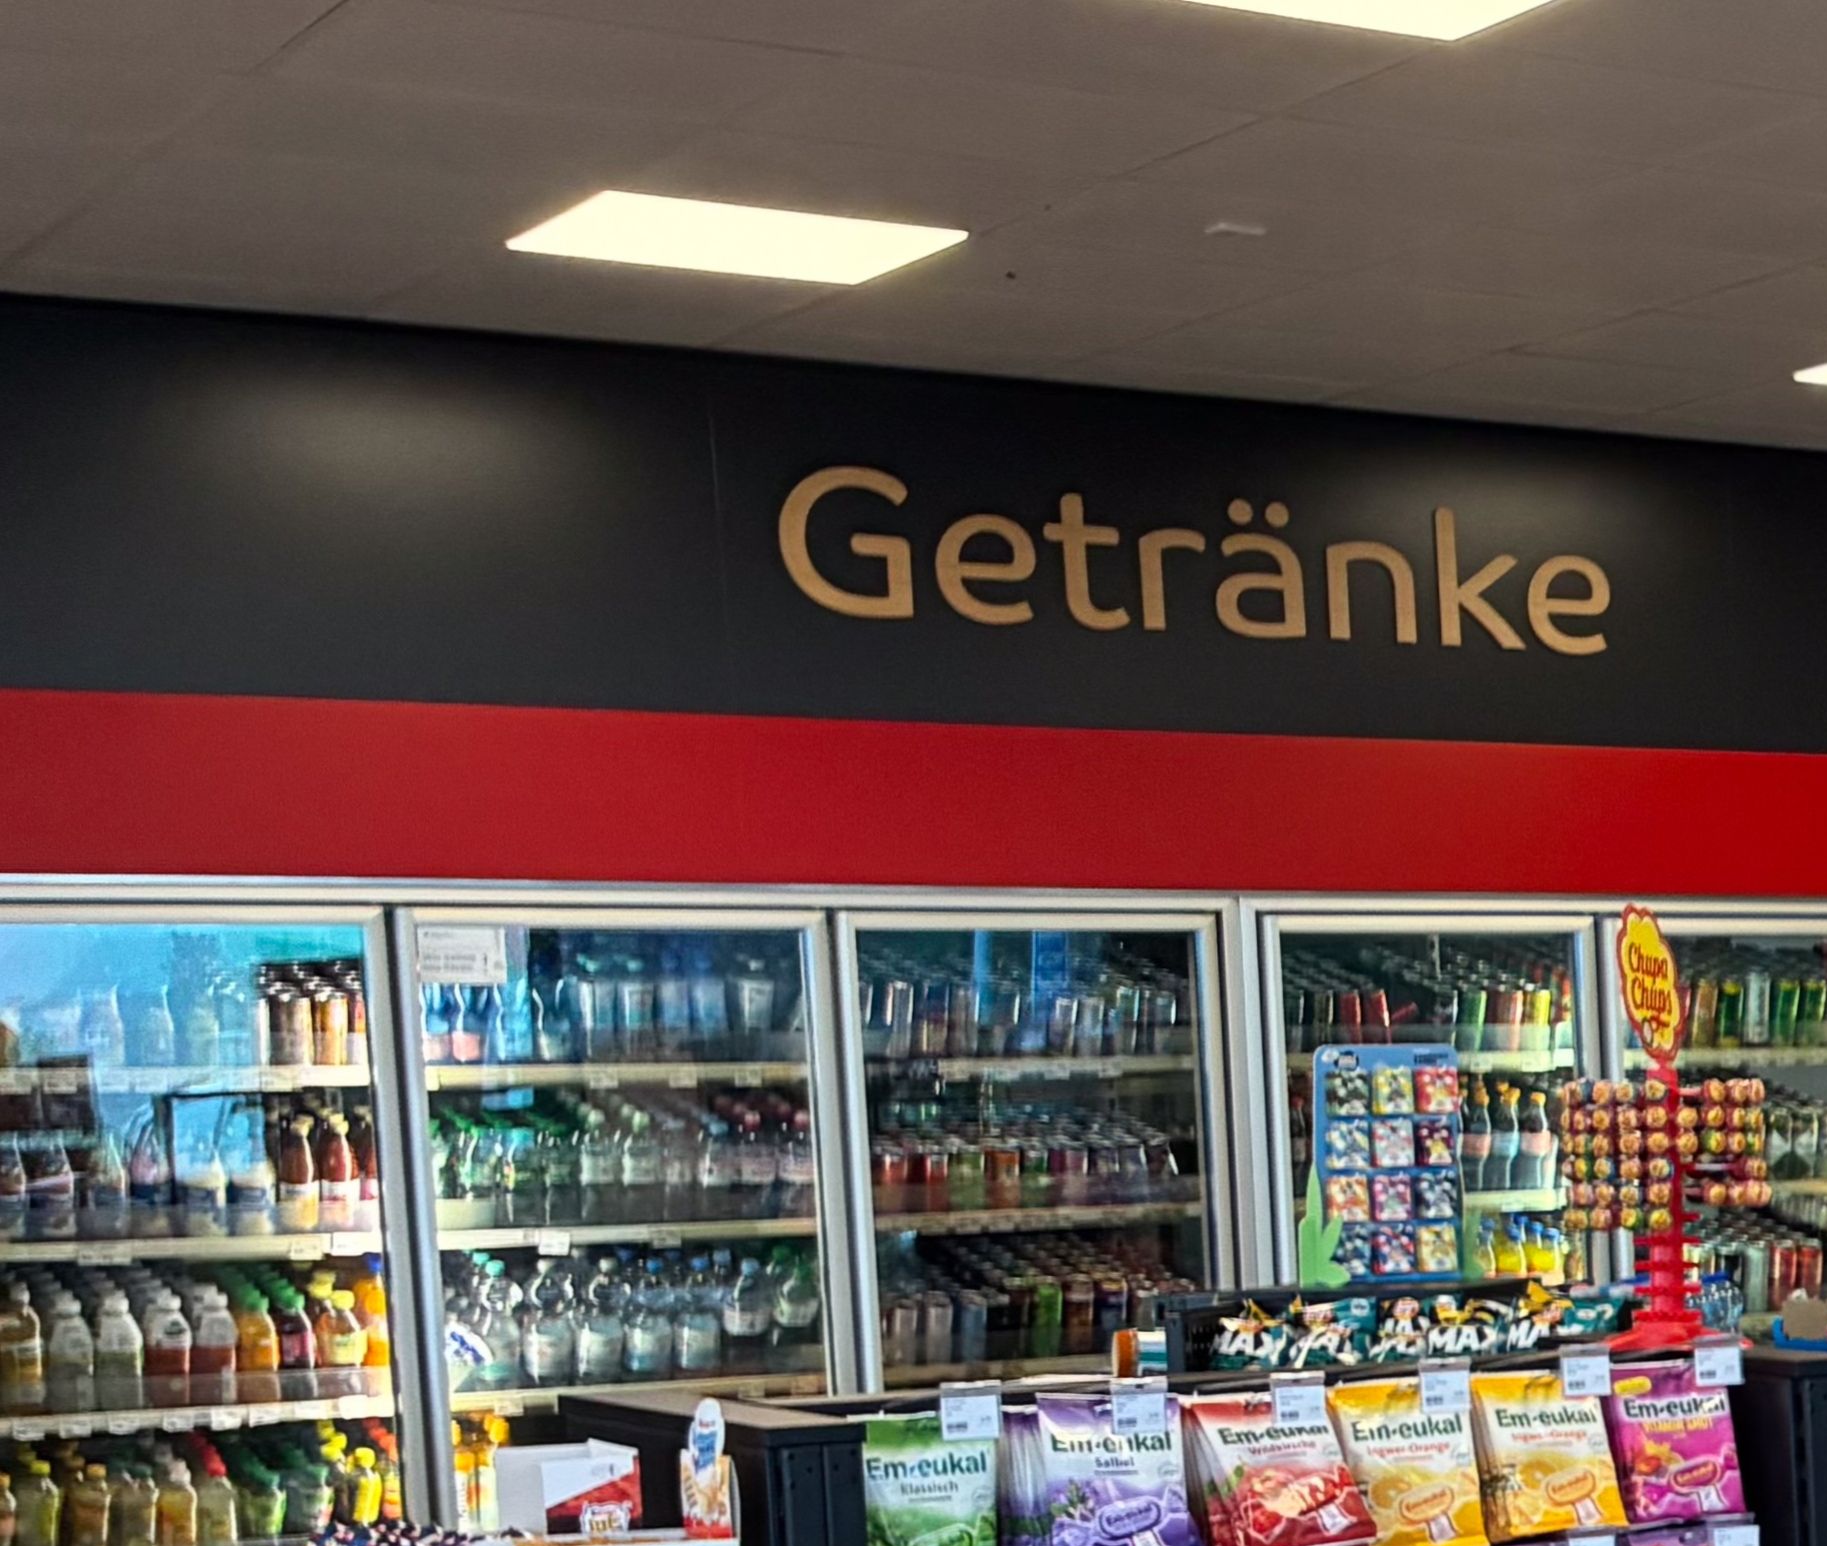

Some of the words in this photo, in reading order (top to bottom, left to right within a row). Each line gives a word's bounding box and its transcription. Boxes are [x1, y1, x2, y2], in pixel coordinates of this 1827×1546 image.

[776, 463, 1614, 657] Getränke
[1629, 942, 1668, 985] Chupa
[1632, 977, 1672, 1015] Chups
[866, 1451, 987, 1481] Em-eukal
[901, 1481, 958, 1496] Klassisch
